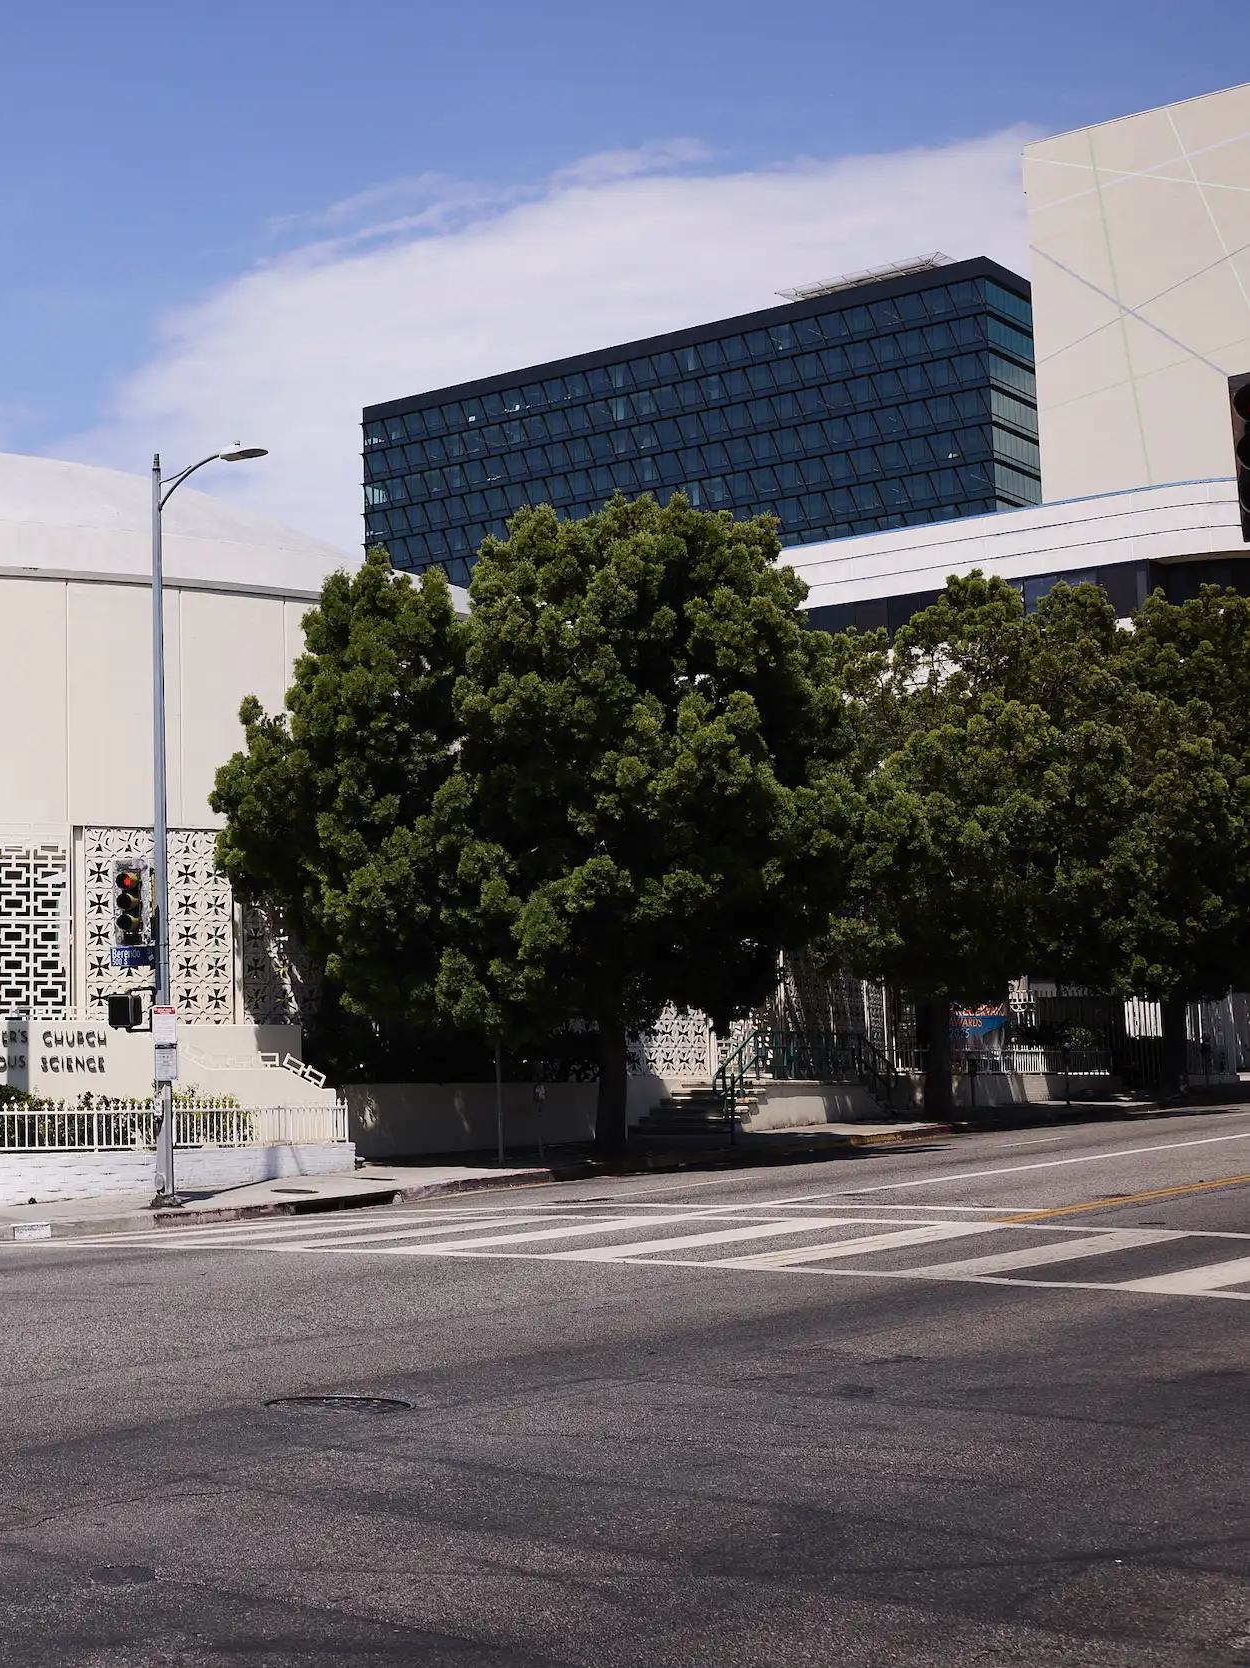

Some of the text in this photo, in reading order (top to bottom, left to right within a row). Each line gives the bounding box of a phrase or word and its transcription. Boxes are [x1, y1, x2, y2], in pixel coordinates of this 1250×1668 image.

[112, 949, 140, 959] Berendo
[42, 1030, 108, 1048] CHURCH
[41, 1055, 106, 1073] SCIENCE
